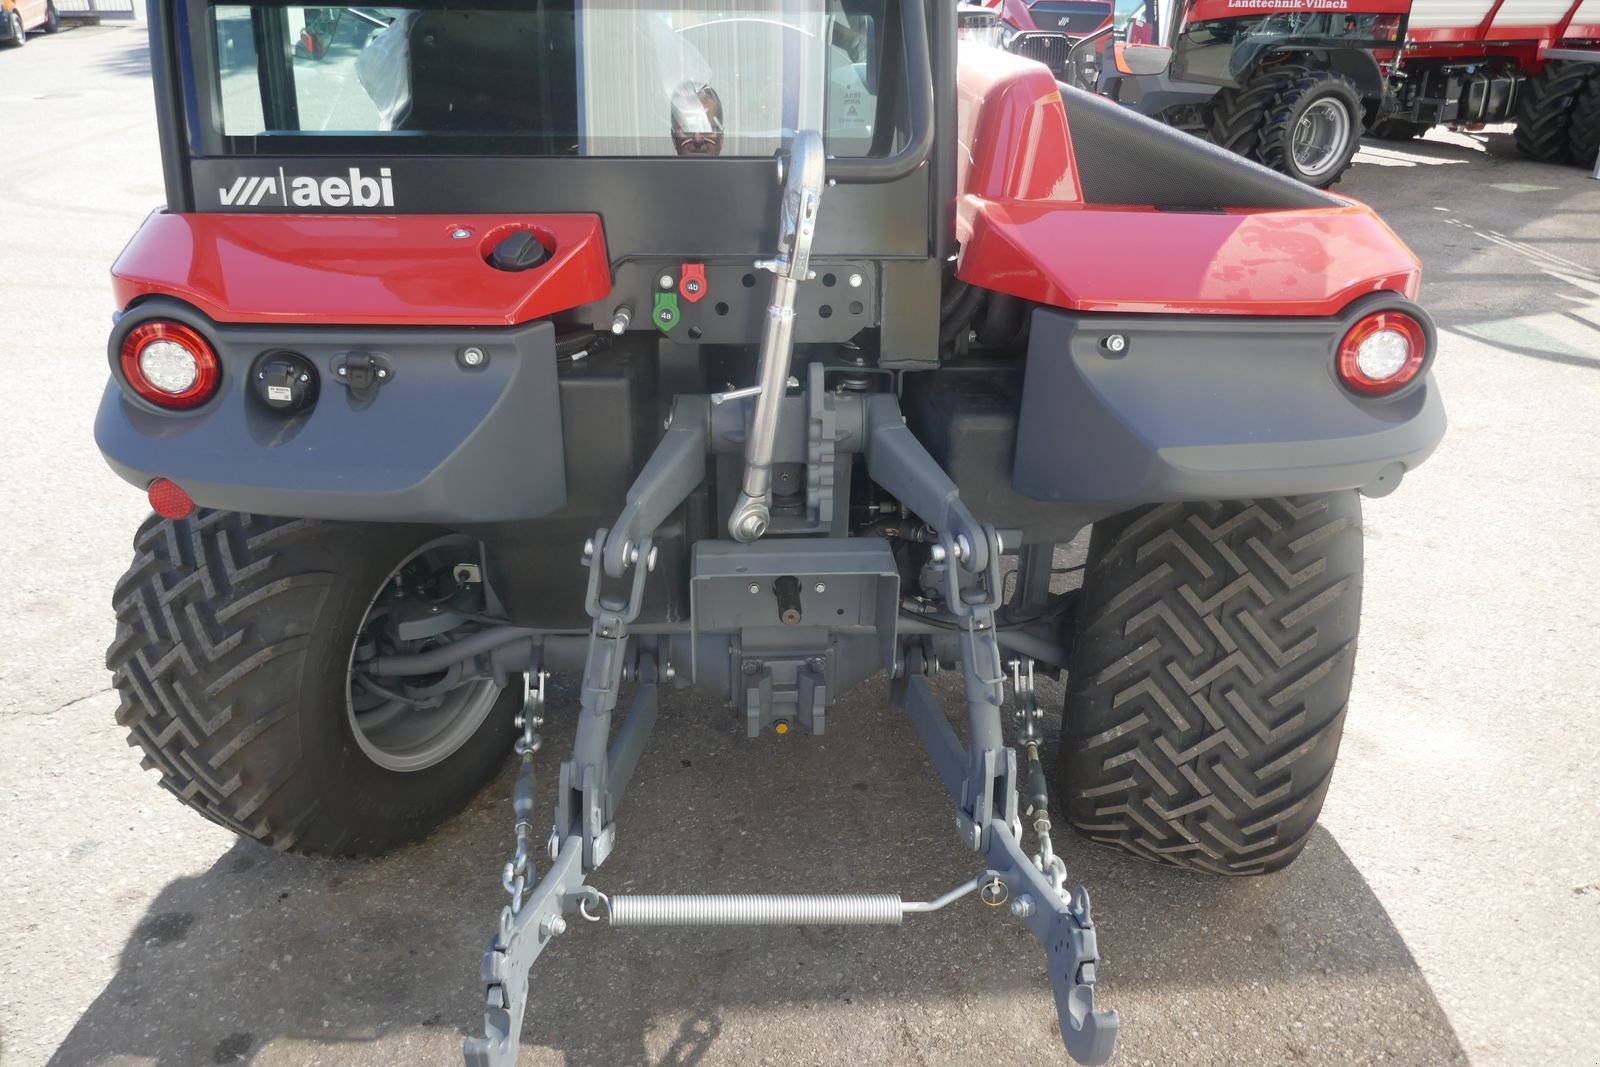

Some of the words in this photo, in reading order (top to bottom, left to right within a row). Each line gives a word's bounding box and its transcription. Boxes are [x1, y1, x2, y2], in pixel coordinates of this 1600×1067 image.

[1227, 0, 1348, 9] Landtechnik-Villach
[292, 167, 395, 207] aebi
[687, 283, 699, 291] 4b
[661, 312, 671, 320] 4a
